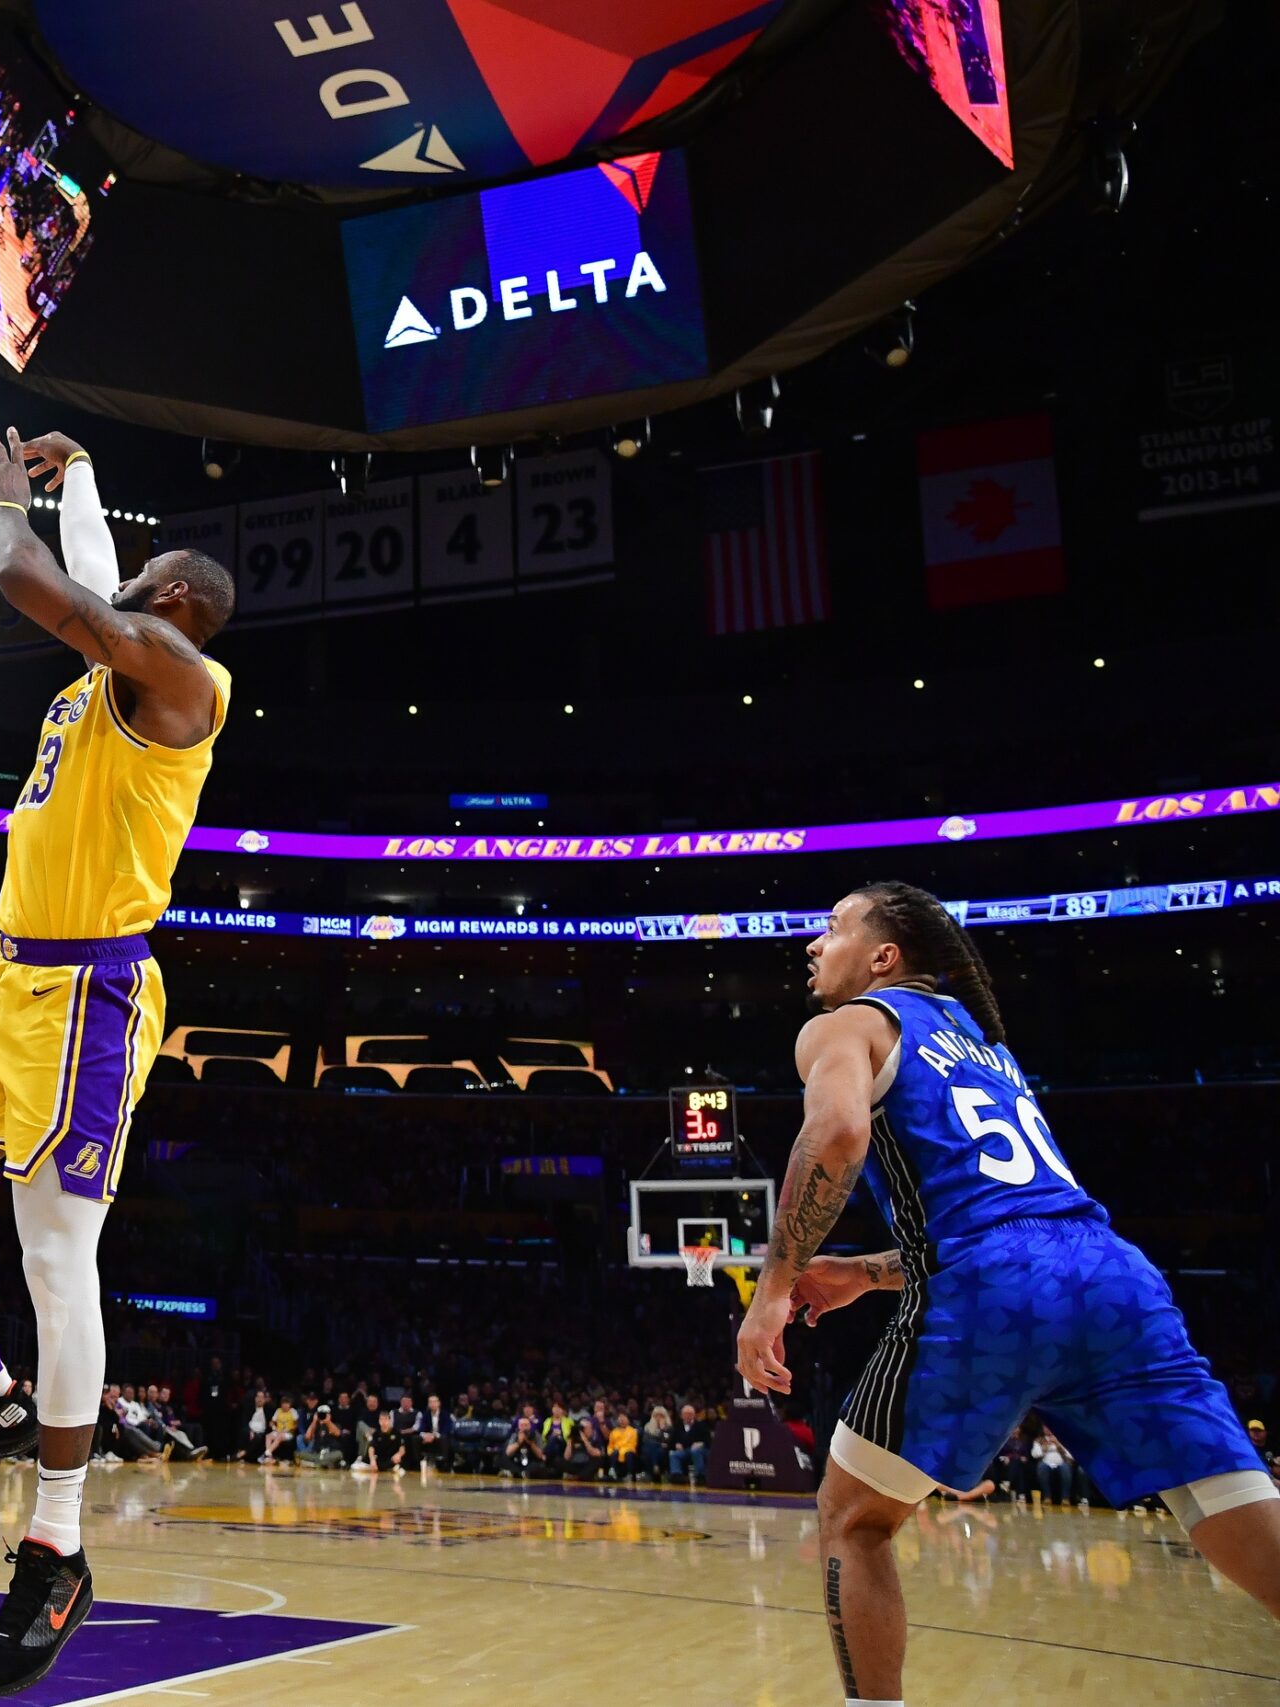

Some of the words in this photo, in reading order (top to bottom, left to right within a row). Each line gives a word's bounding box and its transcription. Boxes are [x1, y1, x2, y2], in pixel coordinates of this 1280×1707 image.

[450, 251, 667, 331] DELTA
[531, 464, 597, 488] BROWN
[245, 506, 316, 531] GRETZKY
[326, 493, 410, 519] ROBITAILLE
[446, 512, 483, 566] 4
[531, 499, 598, 556] 23
[247, 537, 314, 595] 99
[334, 525, 405, 582] 20
[1113, 793, 1206, 823] LOS
[382, 837, 457, 858] LOS
[461, 837, 634, 858] ANGELES
[641, 830, 806, 857] LAKERS
[1233, 883, 1249, 899] A
[190, 911, 211, 925] LA
[215, 912, 276, 928] LAKERS
[986, 905, 1031, 919] Magic
[1065, 895, 1097, 917] 89
[320, 917, 351, 930] MGM
[414, 920, 456, 935] MGM
[460, 920, 539, 935] REWARDS
[543, 920, 559, 935] IS
[563, 921, 576, 935] A
[579, 920, 636, 935] PROUD
[747, 915, 776, 935] 85
[803, 917, 830, 930] Lak
[688, 1091, 728, 1111] 8:43
[685, 1109, 718, 1139] 3.0
[693, 1141, 734, 1153] TISSOT
[950, 1085, 1079, 1190] 50
[154, 1299, 207, 1314] EXPRESS
[826, 1556, 842, 1619] COUNT
